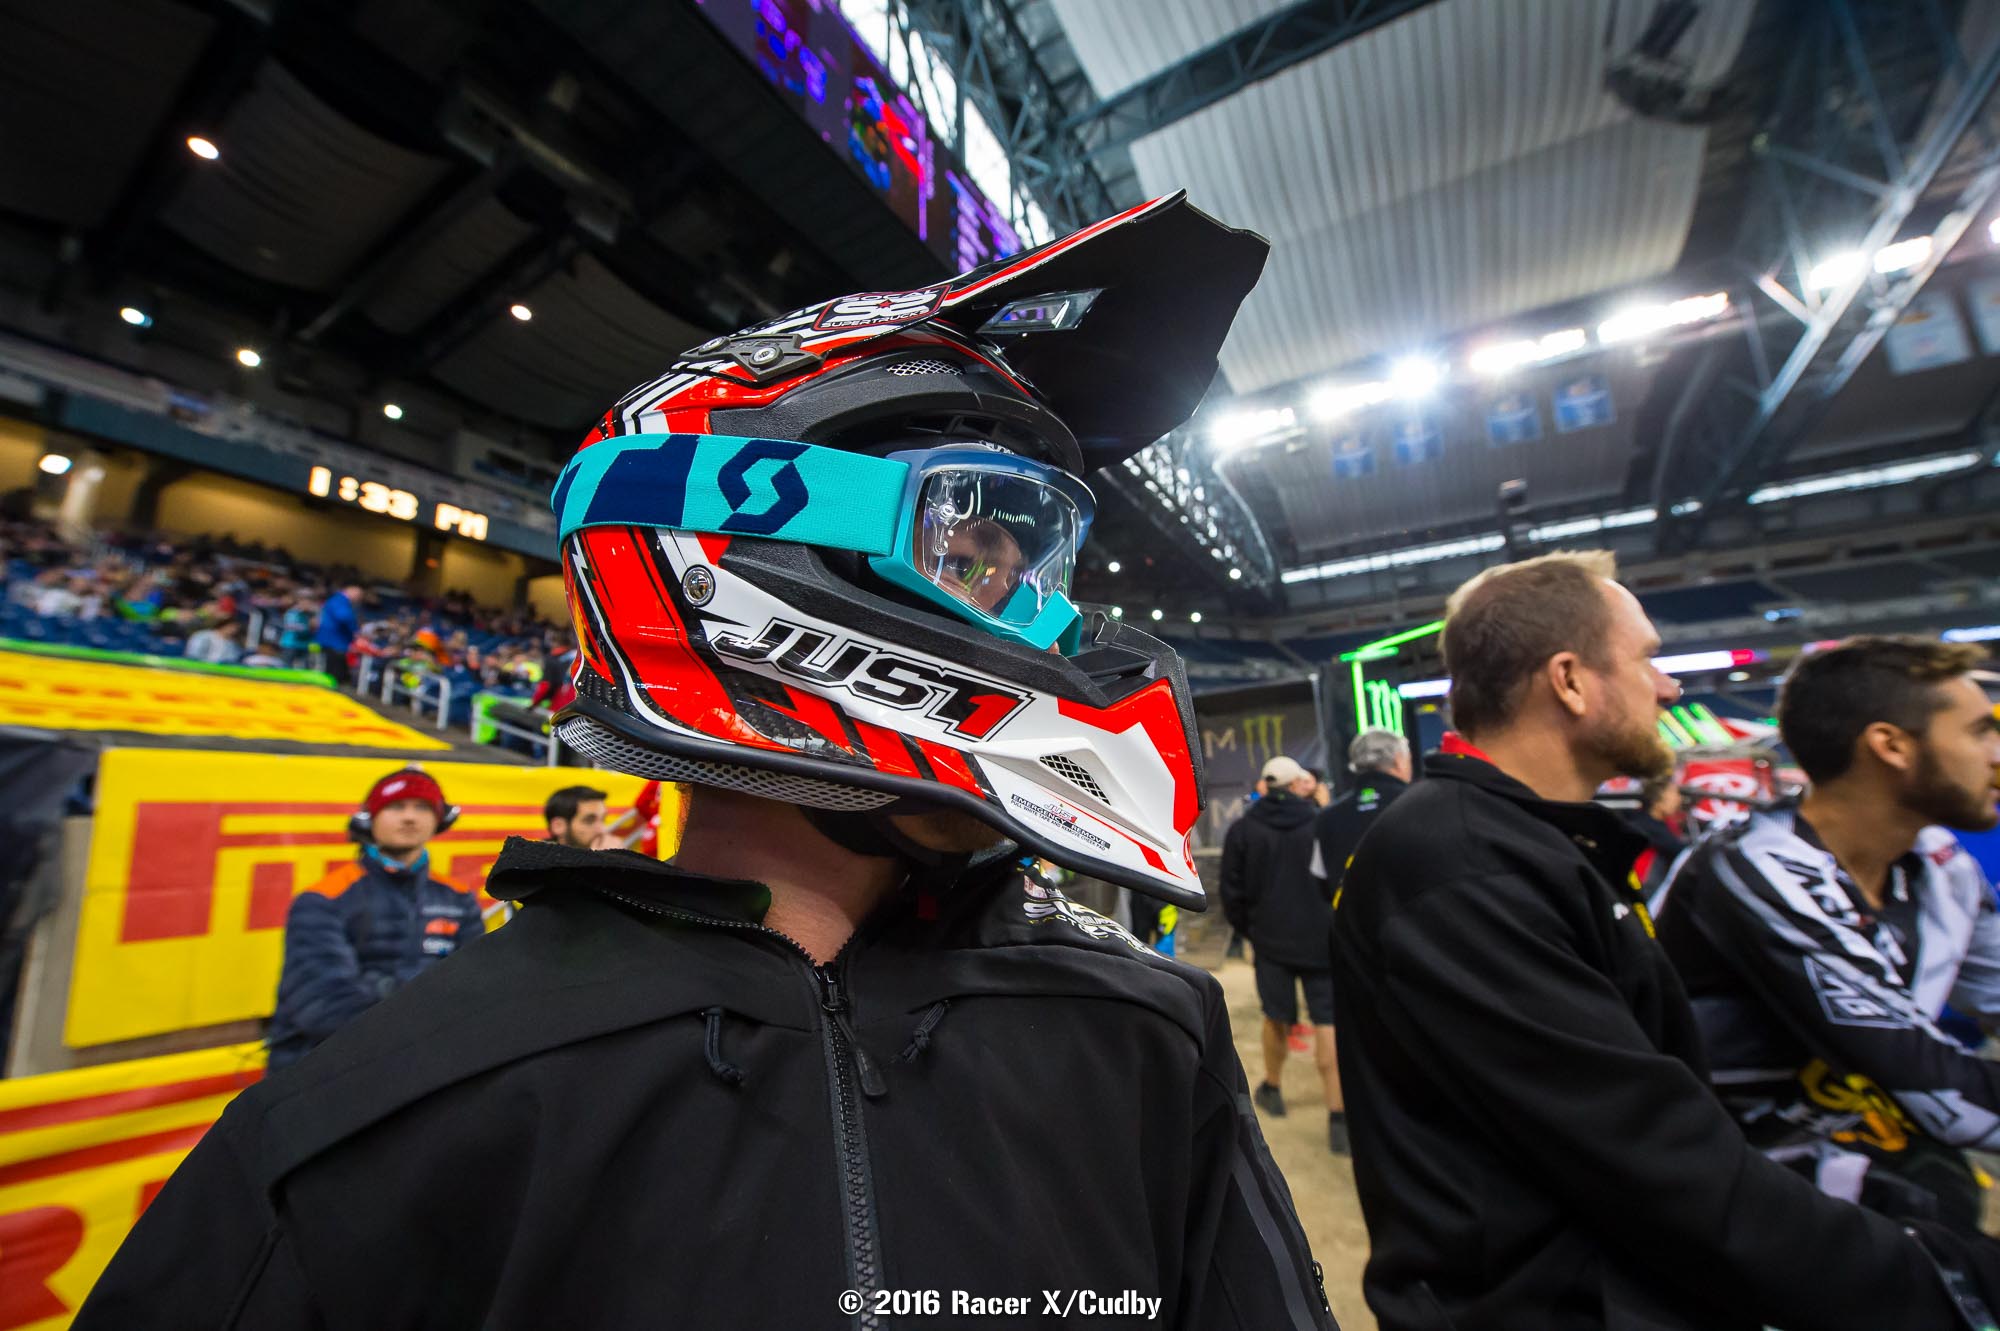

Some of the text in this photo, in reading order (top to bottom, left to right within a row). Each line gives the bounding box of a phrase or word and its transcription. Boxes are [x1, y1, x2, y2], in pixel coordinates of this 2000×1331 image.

[308, 465, 489, 541] 1:33 PM
[709, 617, 1037, 742] JUST1
[1012, 794, 1107, 847] EMERGENCY REMOVE
